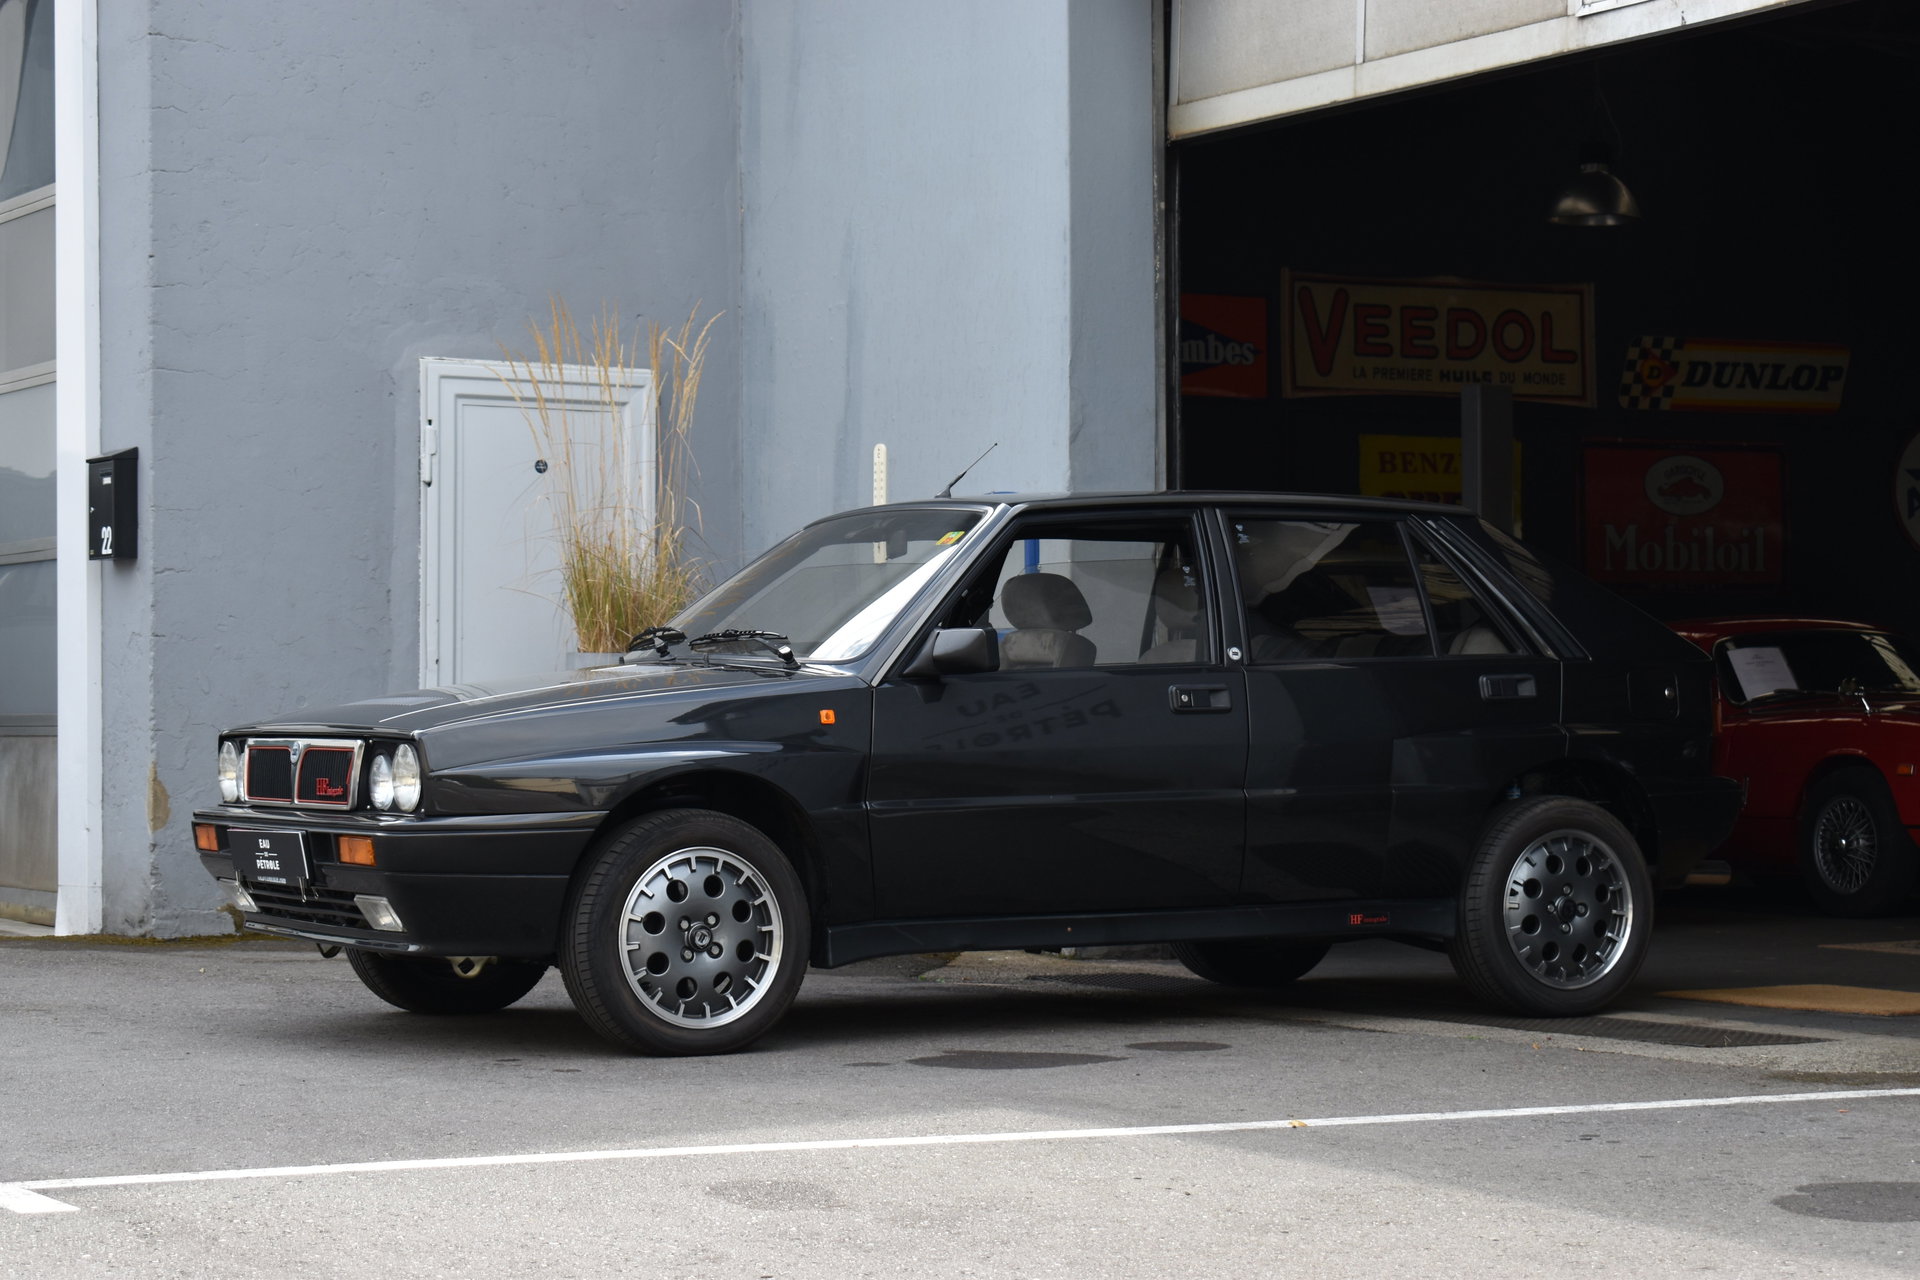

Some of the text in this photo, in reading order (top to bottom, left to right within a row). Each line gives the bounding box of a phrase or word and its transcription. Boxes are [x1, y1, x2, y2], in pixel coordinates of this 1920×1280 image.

[1298, 285, 1578, 377] VEEDOL
[1181, 333, 1255, 365] mbes
[1352, 366, 1566, 385] LA PREMIERE HUILE DU MONDE
[1647, 365, 1662, 379] D
[1681, 361, 1844, 391] DUNLOP
[1378, 451, 1461, 475] BENZ
[101, 526, 112, 555] 22
[1603, 523, 1767, 572] Mobiloil
[258, 838, 270, 849] EAU
[1350, 914, 1364, 925] HF
